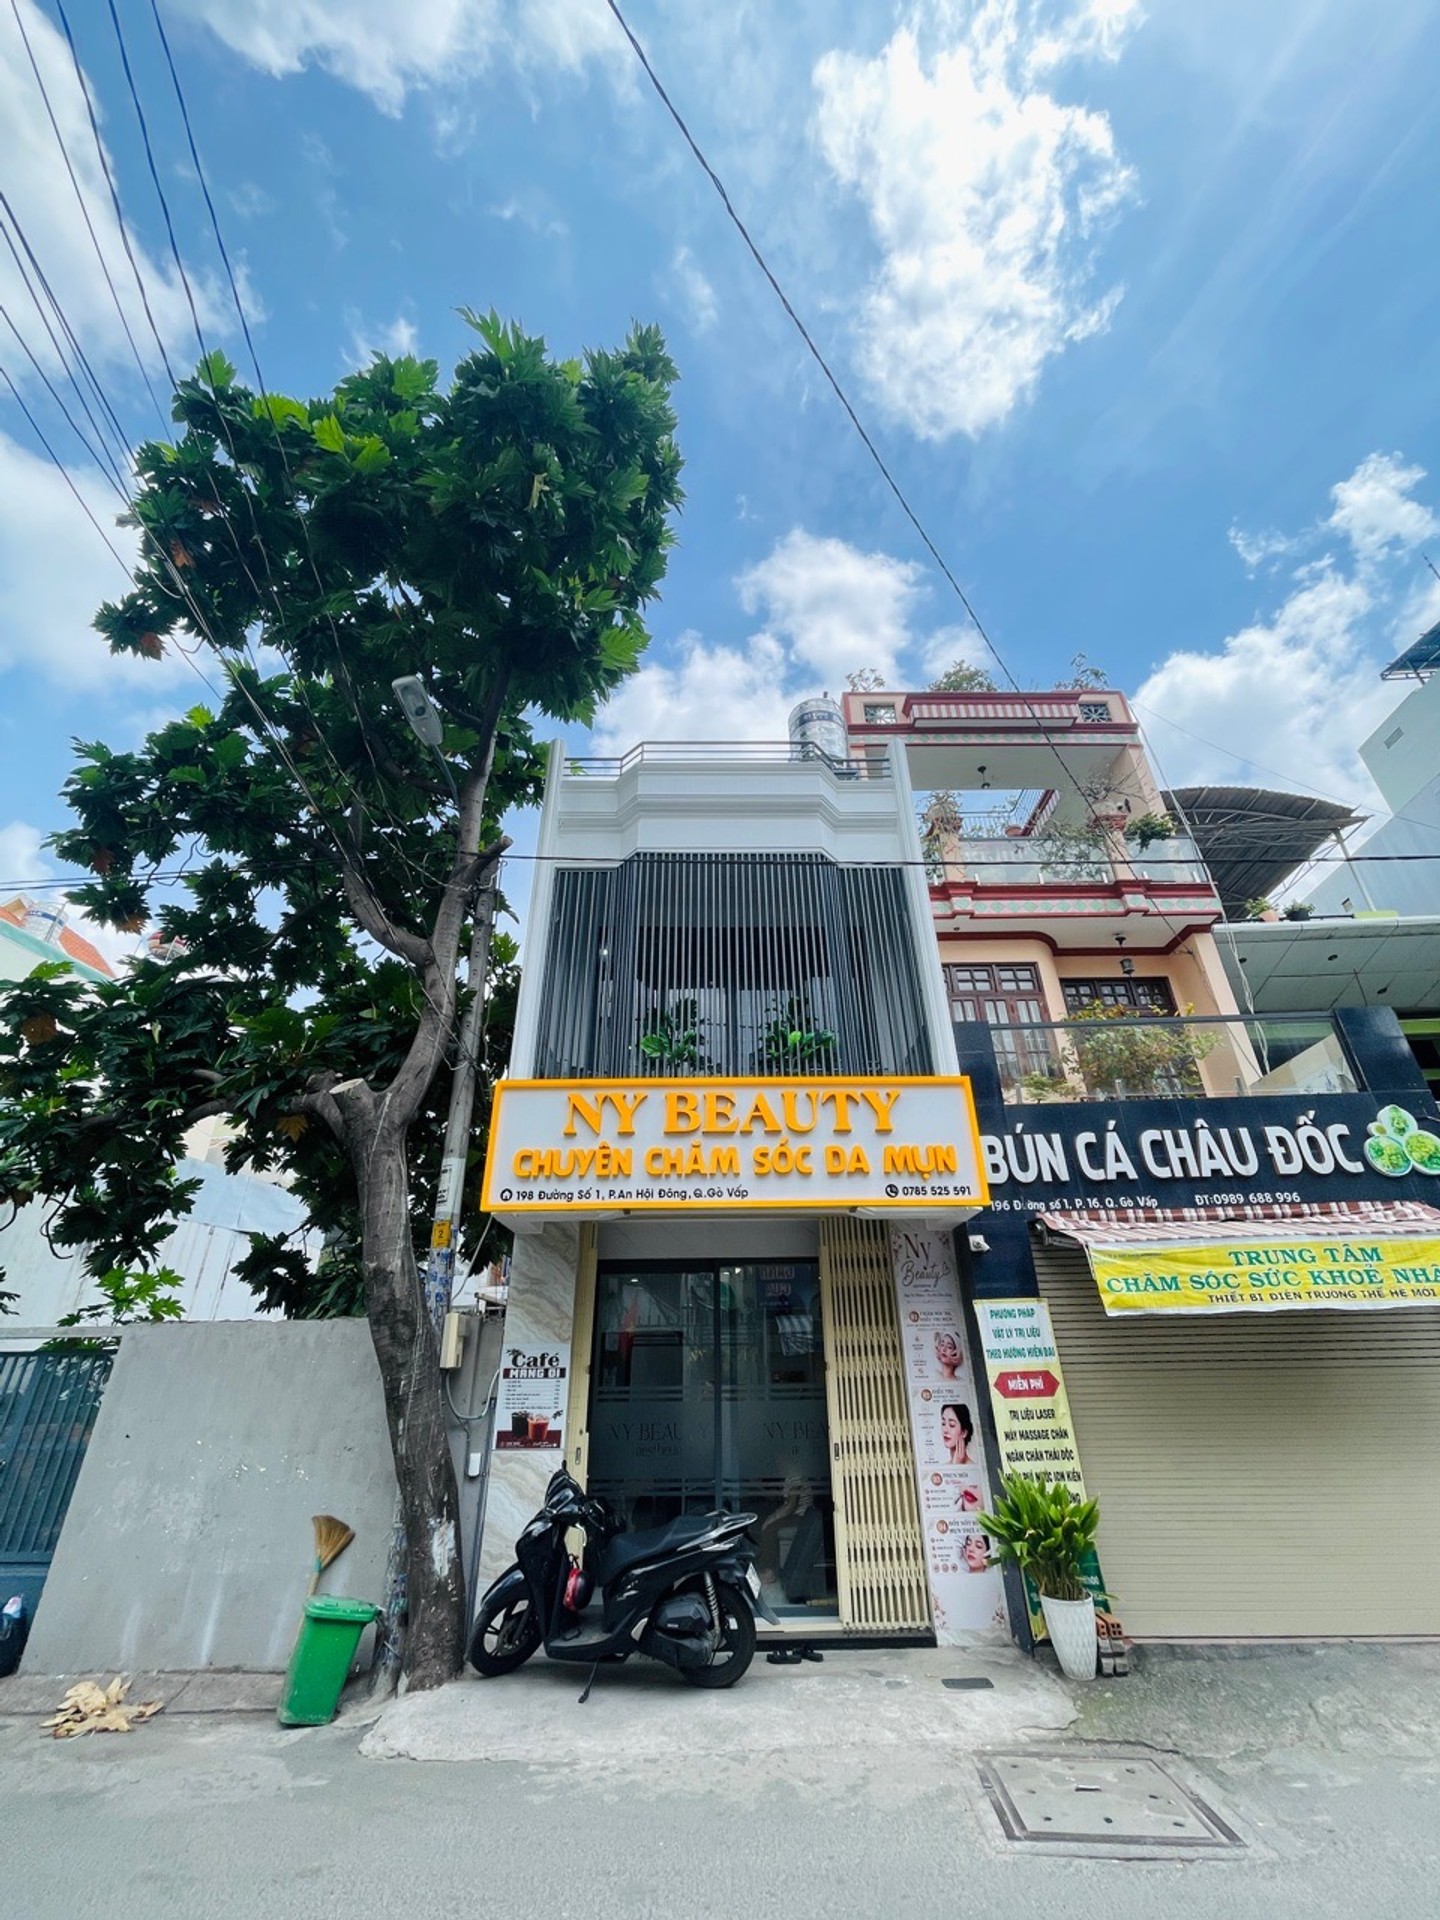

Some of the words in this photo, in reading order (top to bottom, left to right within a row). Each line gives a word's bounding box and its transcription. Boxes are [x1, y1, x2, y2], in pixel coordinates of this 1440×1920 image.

[564, 1091, 648, 1136] NY
[663, 1090, 901, 1135] BEAUTY
[981, 1123, 1070, 1184] BÚN
[1075, 1120, 1138, 1181] CÁ
[1140, 1118, 1259, 1178] CHÂU
[1264, 1110, 1365, 1175] ĐỐC
[512, 1142, 633, 1177] CHUYÊN
[645, 1140, 741, 1176] CHĂM
[754, 1137, 813, 1175] SÓC
[825, 1145, 871, 1174] DA
[883, 1145, 957, 1180] MỤN
[516, 1190, 534, 1200] 198
[538, 1189, 574, 1202] Đường
[577, 1187, 593, 1200] Số
[636, 1188, 654, 1200] Hội
[727, 1184, 749, 1199] Vấp
[902, 1186, 927, 1196] 0785
[930, 1186, 950, 1196] 525
[953, 1185, 971, 1196] 591
[1249, 1193, 1273, 1204] 688
[1275, 1192, 1301, 1203] 996
[991, 1200, 1010, 1211] 196
[1136, 1196, 1158, 1208] Vấp
[438, 1229, 444, 1239] 2
[903, 1233, 931, 1270] Ny
[1228, 1248, 1317, 1266] TRUNG
[1323, 1243, 1384, 1263] TÂM
[901, 1260, 941, 1288] Beauty
[1107, 1272, 1182, 1293] CHĂM
[1248, 1267, 1301, 1288] SỨC
[507, 1351, 559, 1368] Café
[509, 1368, 544, 1378] MANG
[1035, 1408, 1055, 1419] LASER
[1018, 1429, 1050, 1441] MASSAGE
